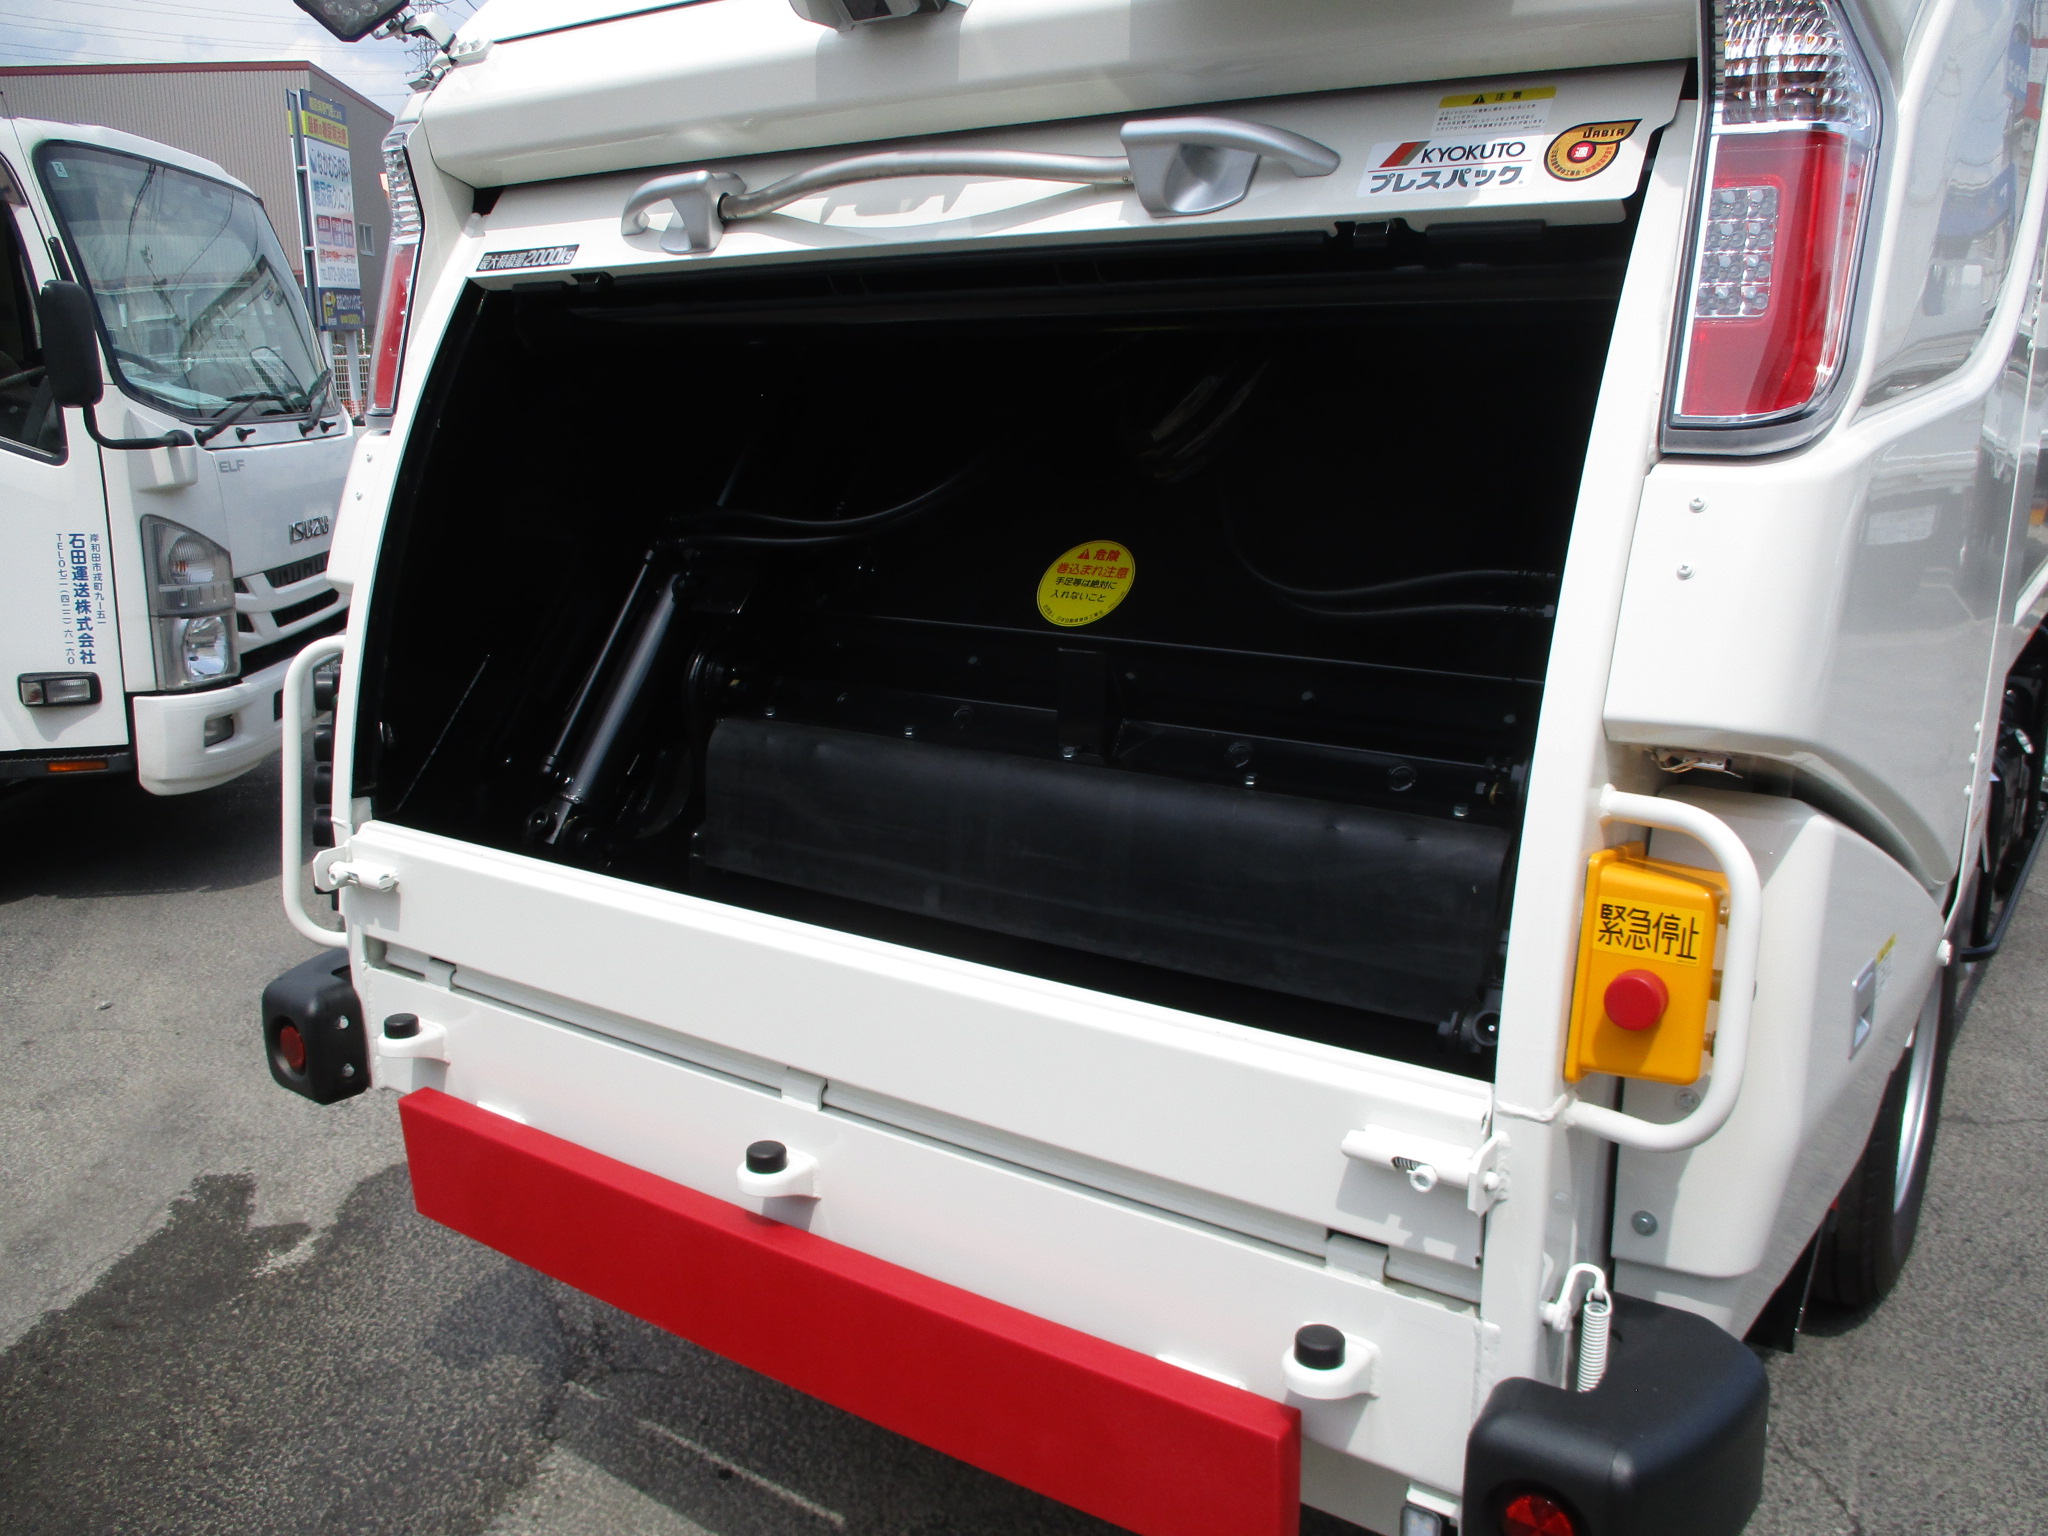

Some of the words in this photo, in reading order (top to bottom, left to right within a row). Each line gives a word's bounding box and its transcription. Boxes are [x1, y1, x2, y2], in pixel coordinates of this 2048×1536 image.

[1583, 127, 1625, 139] JABIA
[1420, 141, 1526, 163] KYOKUTO
[1369, 166, 1524, 194] プレスパック
[219, 460, 245, 473] ELF
[288, 515, 329, 545] ISUZU
[1093, 549, 1121, 562] 危険
[1056, 562, 1130, 579] 巻込まれ注意
[1055, 576, 1118, 590] 手足等は絶対に
[68, 533, 96, 665] 石田運送株式会社
[1050, 589, 1107, 603] 入れないこと
[1597, 903, 1700, 960] 緊急停止
